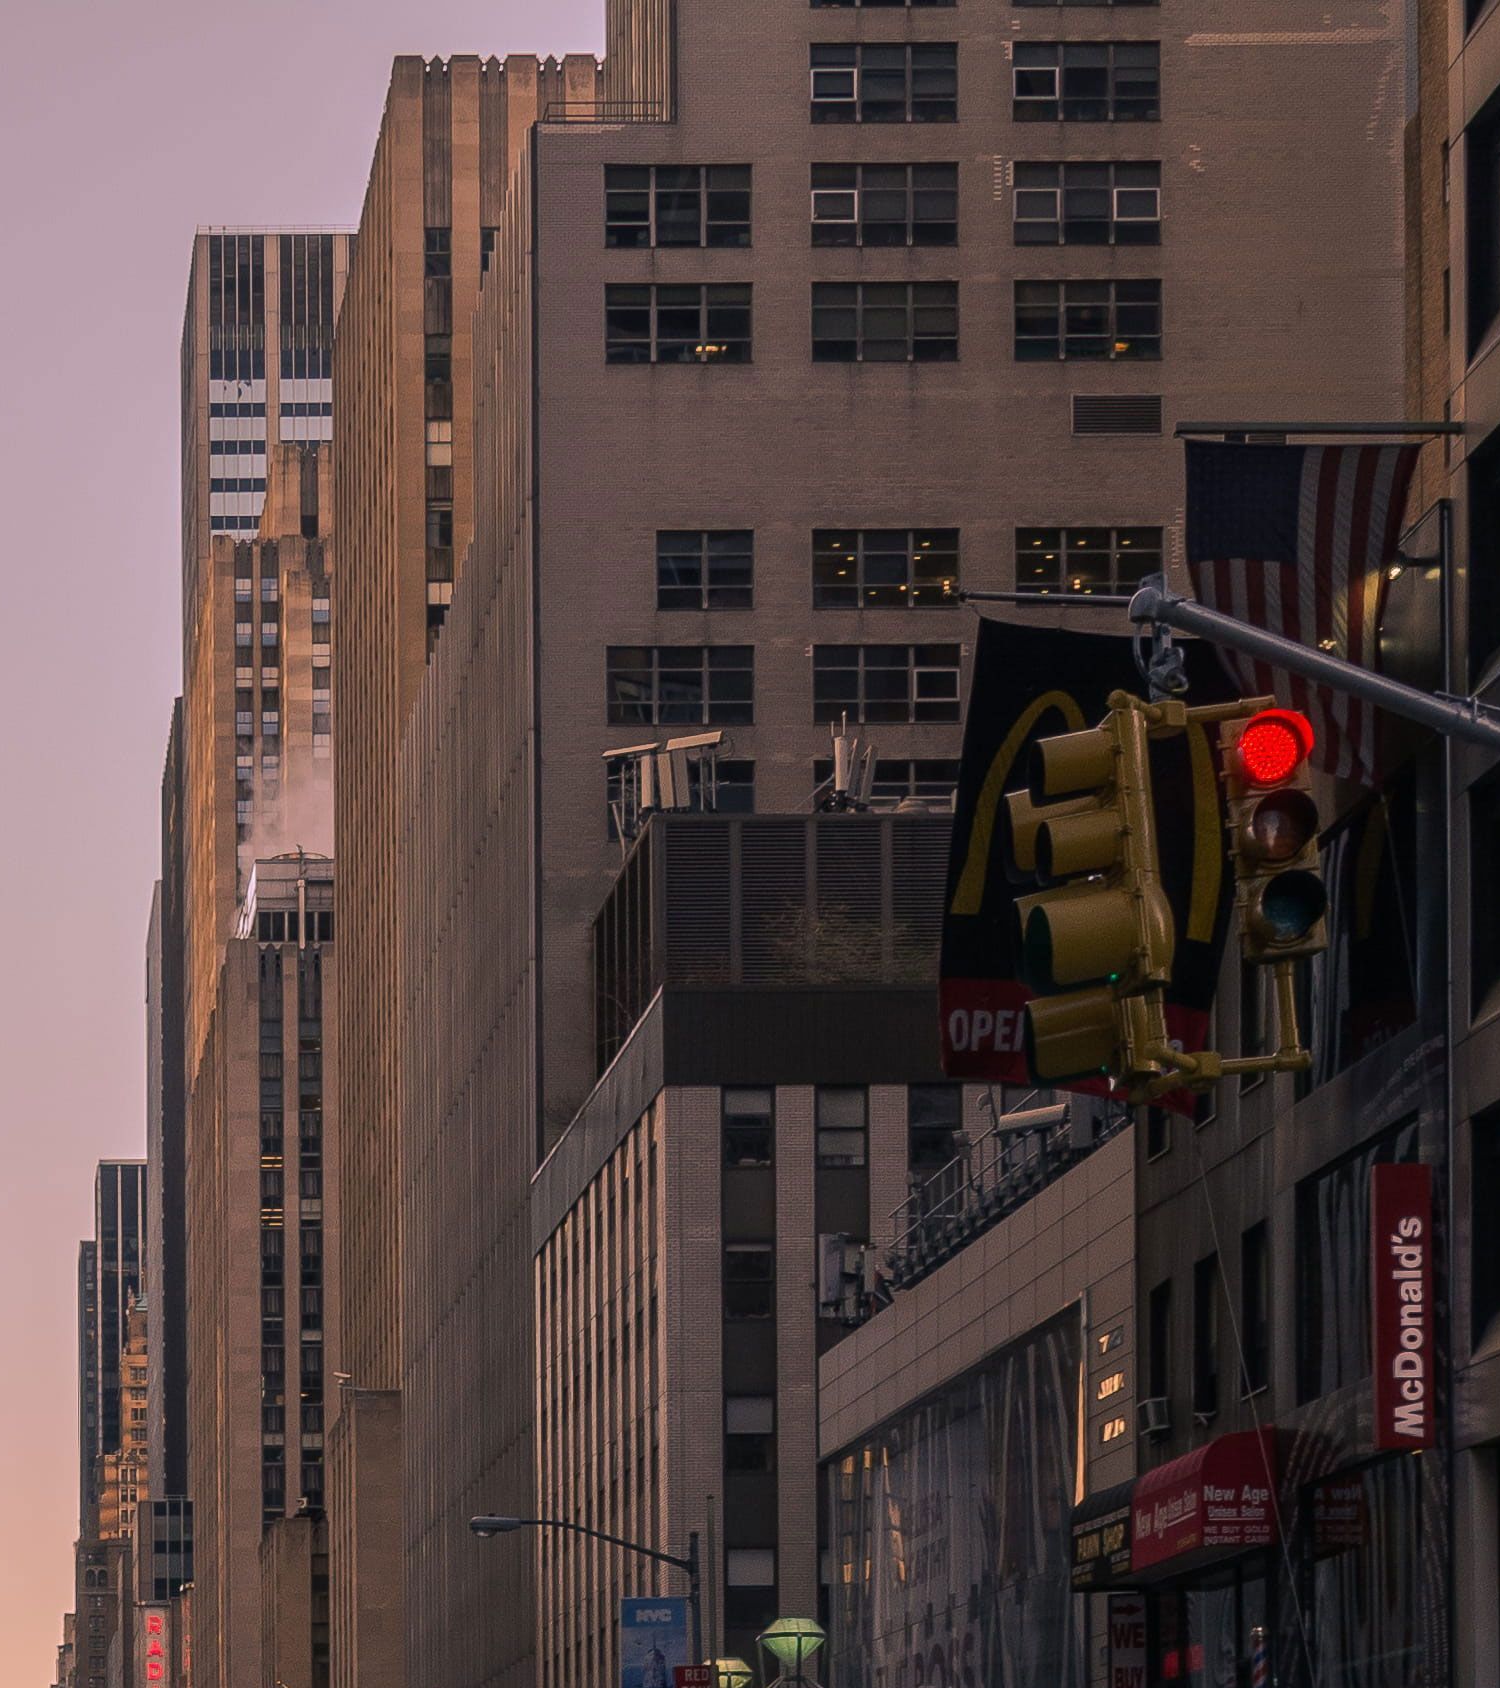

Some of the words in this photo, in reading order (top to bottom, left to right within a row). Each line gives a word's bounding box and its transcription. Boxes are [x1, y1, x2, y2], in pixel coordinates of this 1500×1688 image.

[1390, 1216, 1425, 1439] McDonald's
[1203, 1485, 1235, 1502] New
[1241, 1485, 1269, 1504] Age
[635, 1609, 672, 1623] NYC
[1112, 1622, 1145, 1649] WE
[684, 1669, 709, 1682] RED
